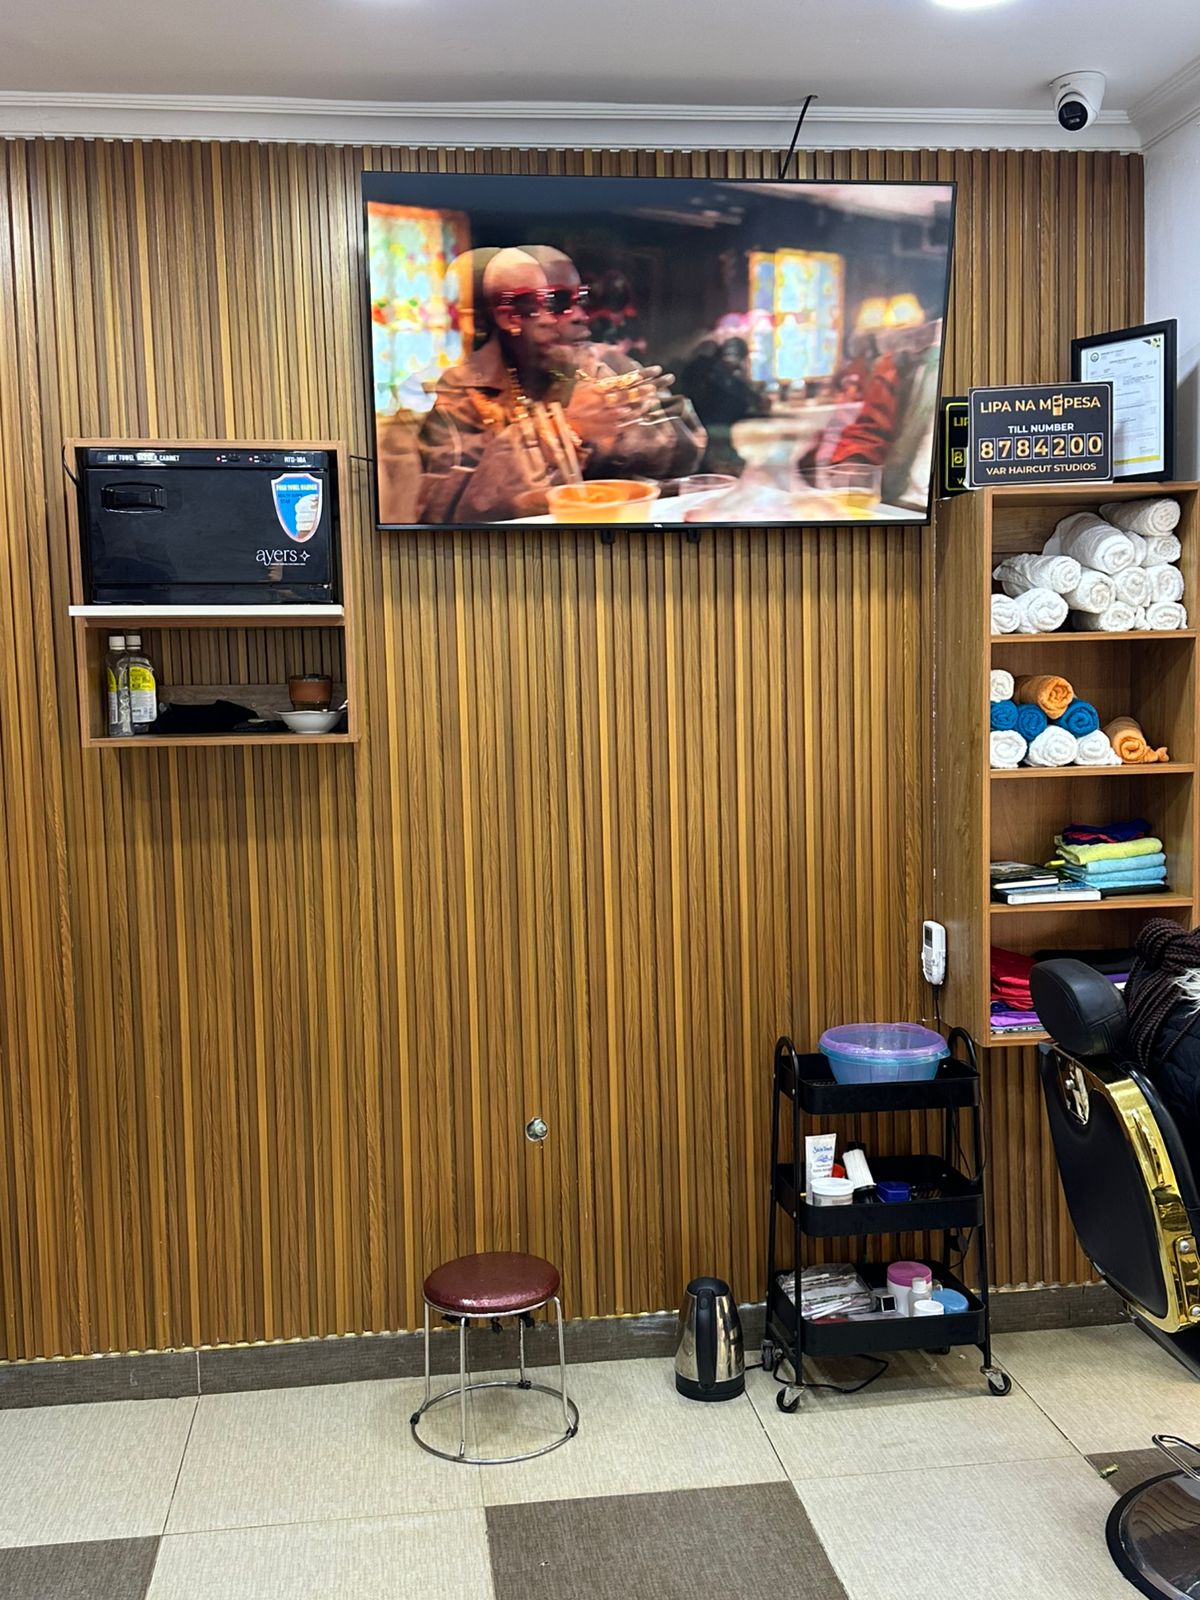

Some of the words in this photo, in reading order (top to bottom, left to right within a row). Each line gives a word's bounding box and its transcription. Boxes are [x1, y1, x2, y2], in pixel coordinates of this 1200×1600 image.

[980, 401, 1012, 414] LIPA
[1015, 399, 1036, 412] NA
[1008, 425, 1028, 434] TILL
[1030, 422, 1075, 433] NUMBER
[980, 435, 1102, 459] 8784200
[986, 467, 1007, 475] VAR
[1008, 464, 1052, 475] HAIRCUT
[1053, 462, 1097, 473] STUDIOS
[255, 549, 298, 566] ayers
